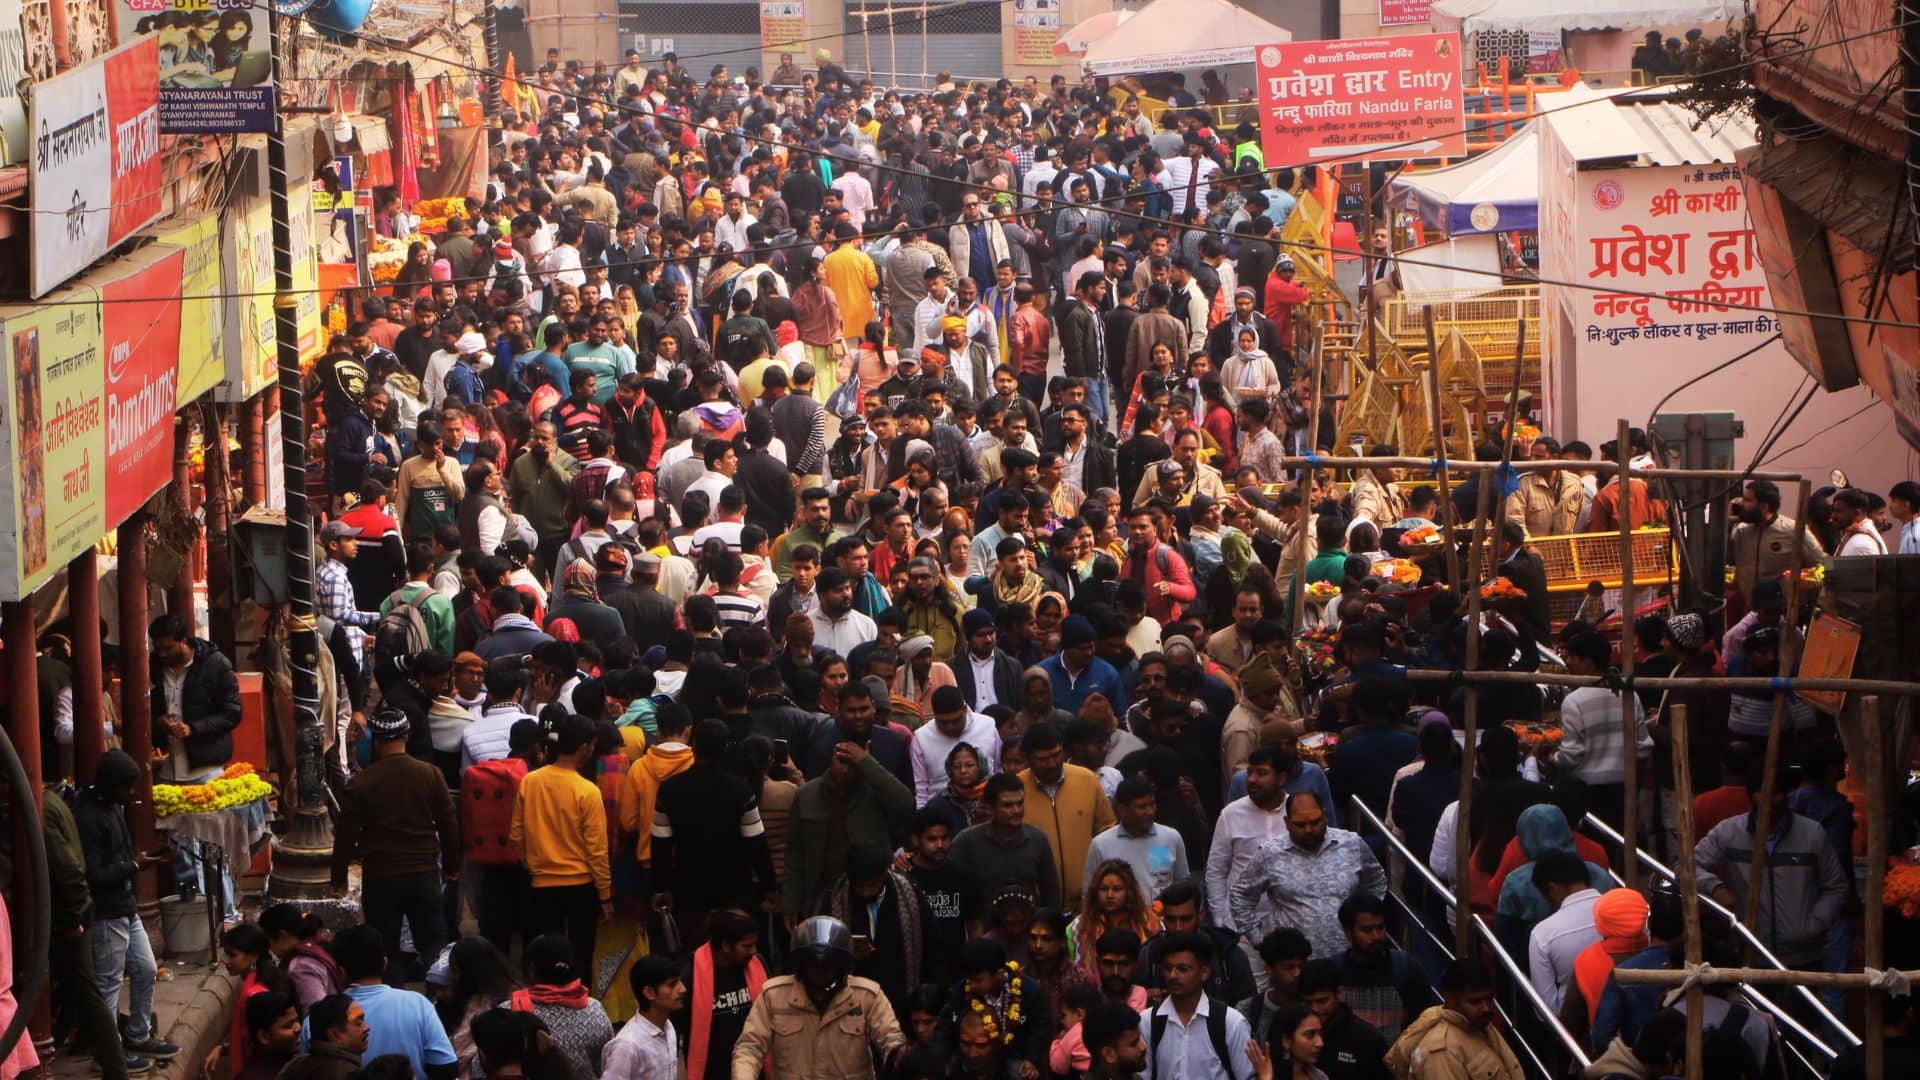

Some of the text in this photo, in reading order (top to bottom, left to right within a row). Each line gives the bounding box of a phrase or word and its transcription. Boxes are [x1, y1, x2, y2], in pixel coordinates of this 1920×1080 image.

[233, 90, 263, 100] TRUST
[1268, 69, 1453, 101] प्रवेश द्वार Entry
[170, 102, 191, 110] KASHI
[192, 102, 238, 110] VISHWANATH
[240, 102, 266, 110] TEMPLE
[1271, 96, 1453, 125] नन्दू फारिया Nandu Faria
[37, 118, 50, 173] श्री
[52, 112, 97, 168] सत्यनारायण
[1708, 166, 1730, 182] काशी
[1649, 185, 1741, 217] श्री काशी
[1588, 224, 1691, 279] प्रवेश
[1707, 228, 1762, 280] द्वा
[1592, 280, 1765, 327] नन्दू फारिया
[1643, 322, 1681, 340] लॉकर
[1683, 323, 1693, 337] व
[1755, 314, 1773, 333] की
[46, 401, 65, 453] आदि
[108, 366, 175, 457] Bumchums
[63, 448, 90, 504] नाथ जी
